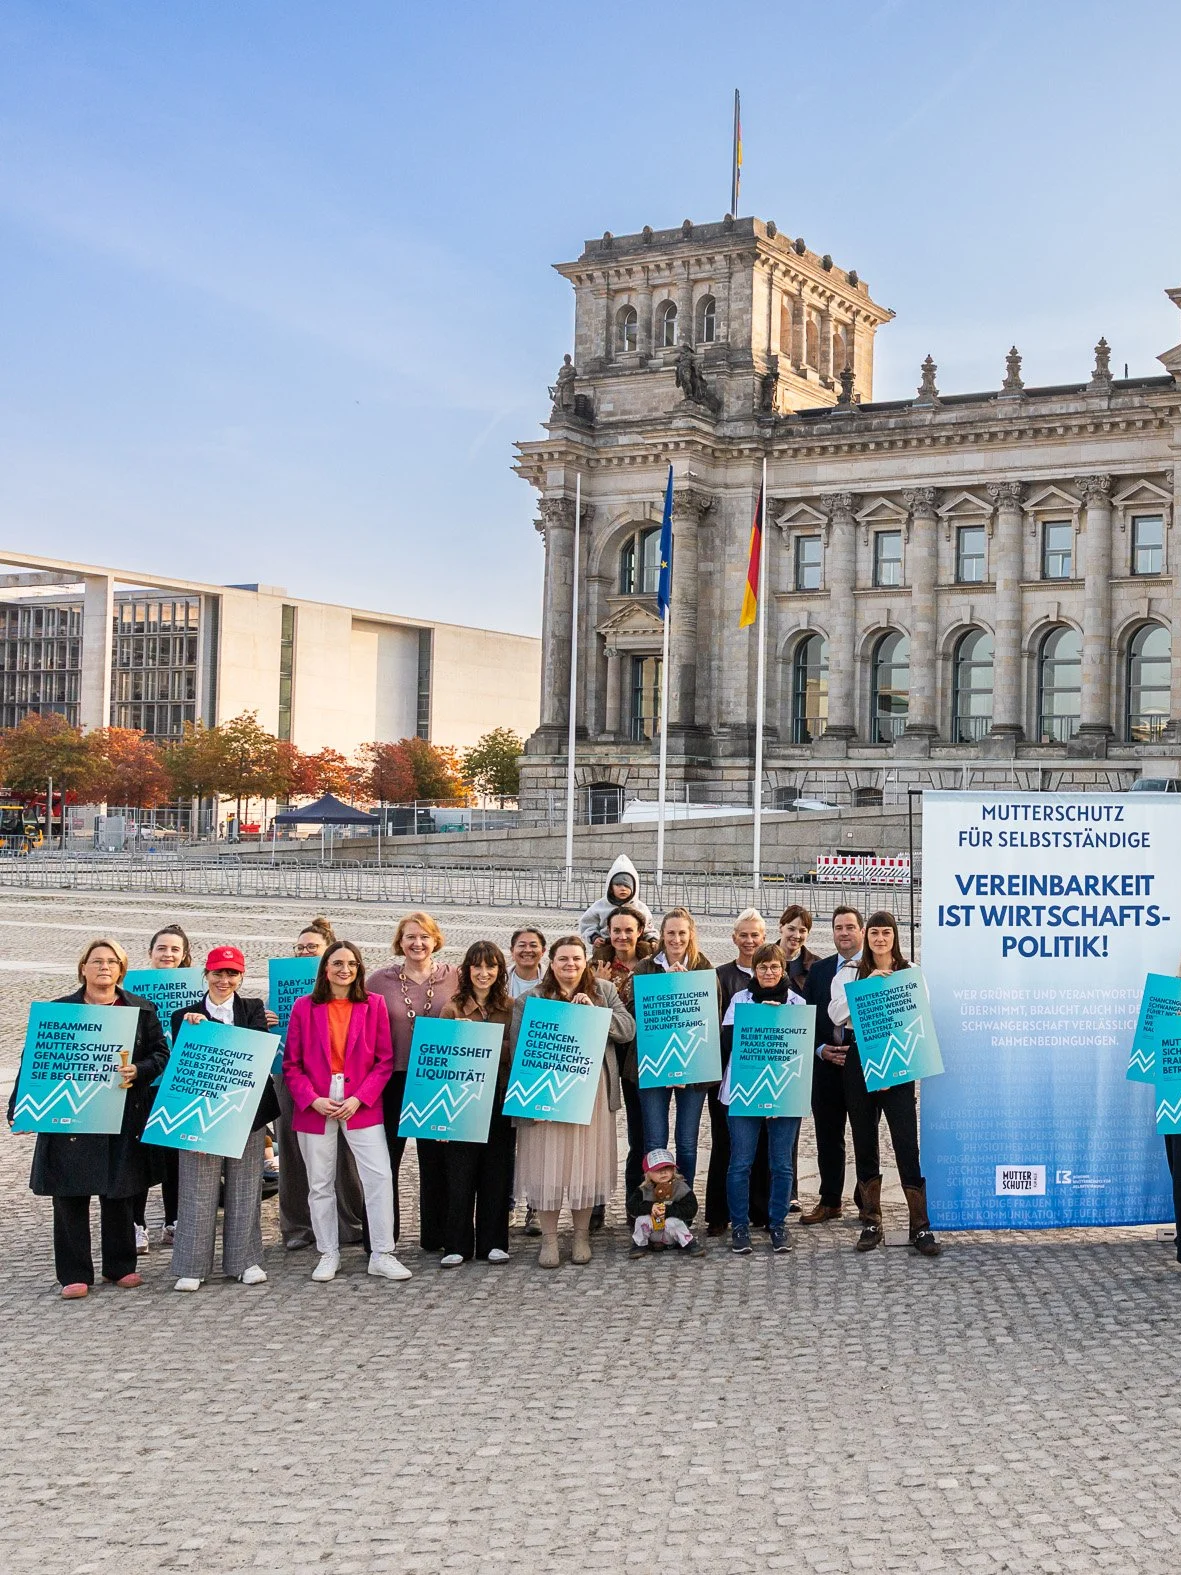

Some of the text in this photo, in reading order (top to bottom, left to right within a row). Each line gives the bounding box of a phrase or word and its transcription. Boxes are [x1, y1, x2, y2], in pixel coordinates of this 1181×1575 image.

[982, 805, 1124, 821] MUTTERSCHUTZ
[959, 827, 1150, 848] FÜR SELBSTSTÄNDIGE
[955, 875, 1154, 896] VEREINBARKEIT
[938, 905, 1170, 926] IST WIRTSCHAFTS-
[1002, 935, 1108, 957] POLITIK!
[133, 984, 150, 992] MIT
[278, 987, 307, 995] LÄUFT.
[855, 983, 918, 1002] MUTTERSCHUTZ FÜR
[953, 988, 1144, 999] WER GRÜNDET UND VERANTWORTU
[657, 991, 708, 1001] GESETZLICHEM
[857, 992, 911, 1009] SELBSTSTÄNDIGE:
[643, 999, 698, 1009] MUTTERSCHUTZ
[858, 998, 912, 1016] GESUND WERDEN
[961, 1003, 1125, 1016] ÜBERNIMMT, BRAUCHT AUCH IN
[644, 1006, 700, 1016] BLEIBEN FRAUEN
[859, 1012, 886, 1022] DÜRFEN,
[39, 1021, 102, 1031] HEBAMMEN
[530, 1020, 559, 1031] ECHTE
[645, 1020, 705, 1031] ZUKUNFTSFÄHIG.
[872, 1017, 894, 1026] EIGENE
[962, 1020, 1070, 1031] SCHWANGERSCHAFT
[37, 1032, 75, 1040] HABEN
[862, 1024, 893, 1035] EXISTENZ
[528, 1030, 578, 1043] CHANCEN-
[864, 1031, 892, 1042] BANGEN.
[992, 1035, 1118, 1047] RAHMENBEDINGUNGEN.
[35, 1042, 123, 1052] MUTTERSCHUTZ
[184, 1042, 254, 1061] MUTTERSCHUTZ
[420, 1044, 492, 1058] GEWISSHEIT
[526, 1040, 581, 1055] GLEICHHEIT,
[34, 1052, 89, 1061] GENAUSO
[181, 1051, 234, 1066] MUSS AUCH
[418, 1053, 448, 1067] ÜBER
[524, 1050, 593, 1065] GESCHLECHTS-
[52, 1059, 98, 1072] MÜTTER,
[178, 1058, 253, 1078] SELBSTSTÄNDIGE
[522, 1059, 590, 1075] UNABHÄNGIG!
[50, 1073, 110, 1082] BEGLEITEN.
[176, 1067, 255, 1088] VOR BERUFLICHEN
[416, 1069, 485, 1082] LIQUIDITÄT!
[172, 1076, 227, 1092] NACHTEILEN
[169, 1084, 219, 1099] SCHÜTZEN.
[1003, 1171, 1032, 1180] MUTTER
[1003, 1181, 1032, 1189] SCHUTZ!
